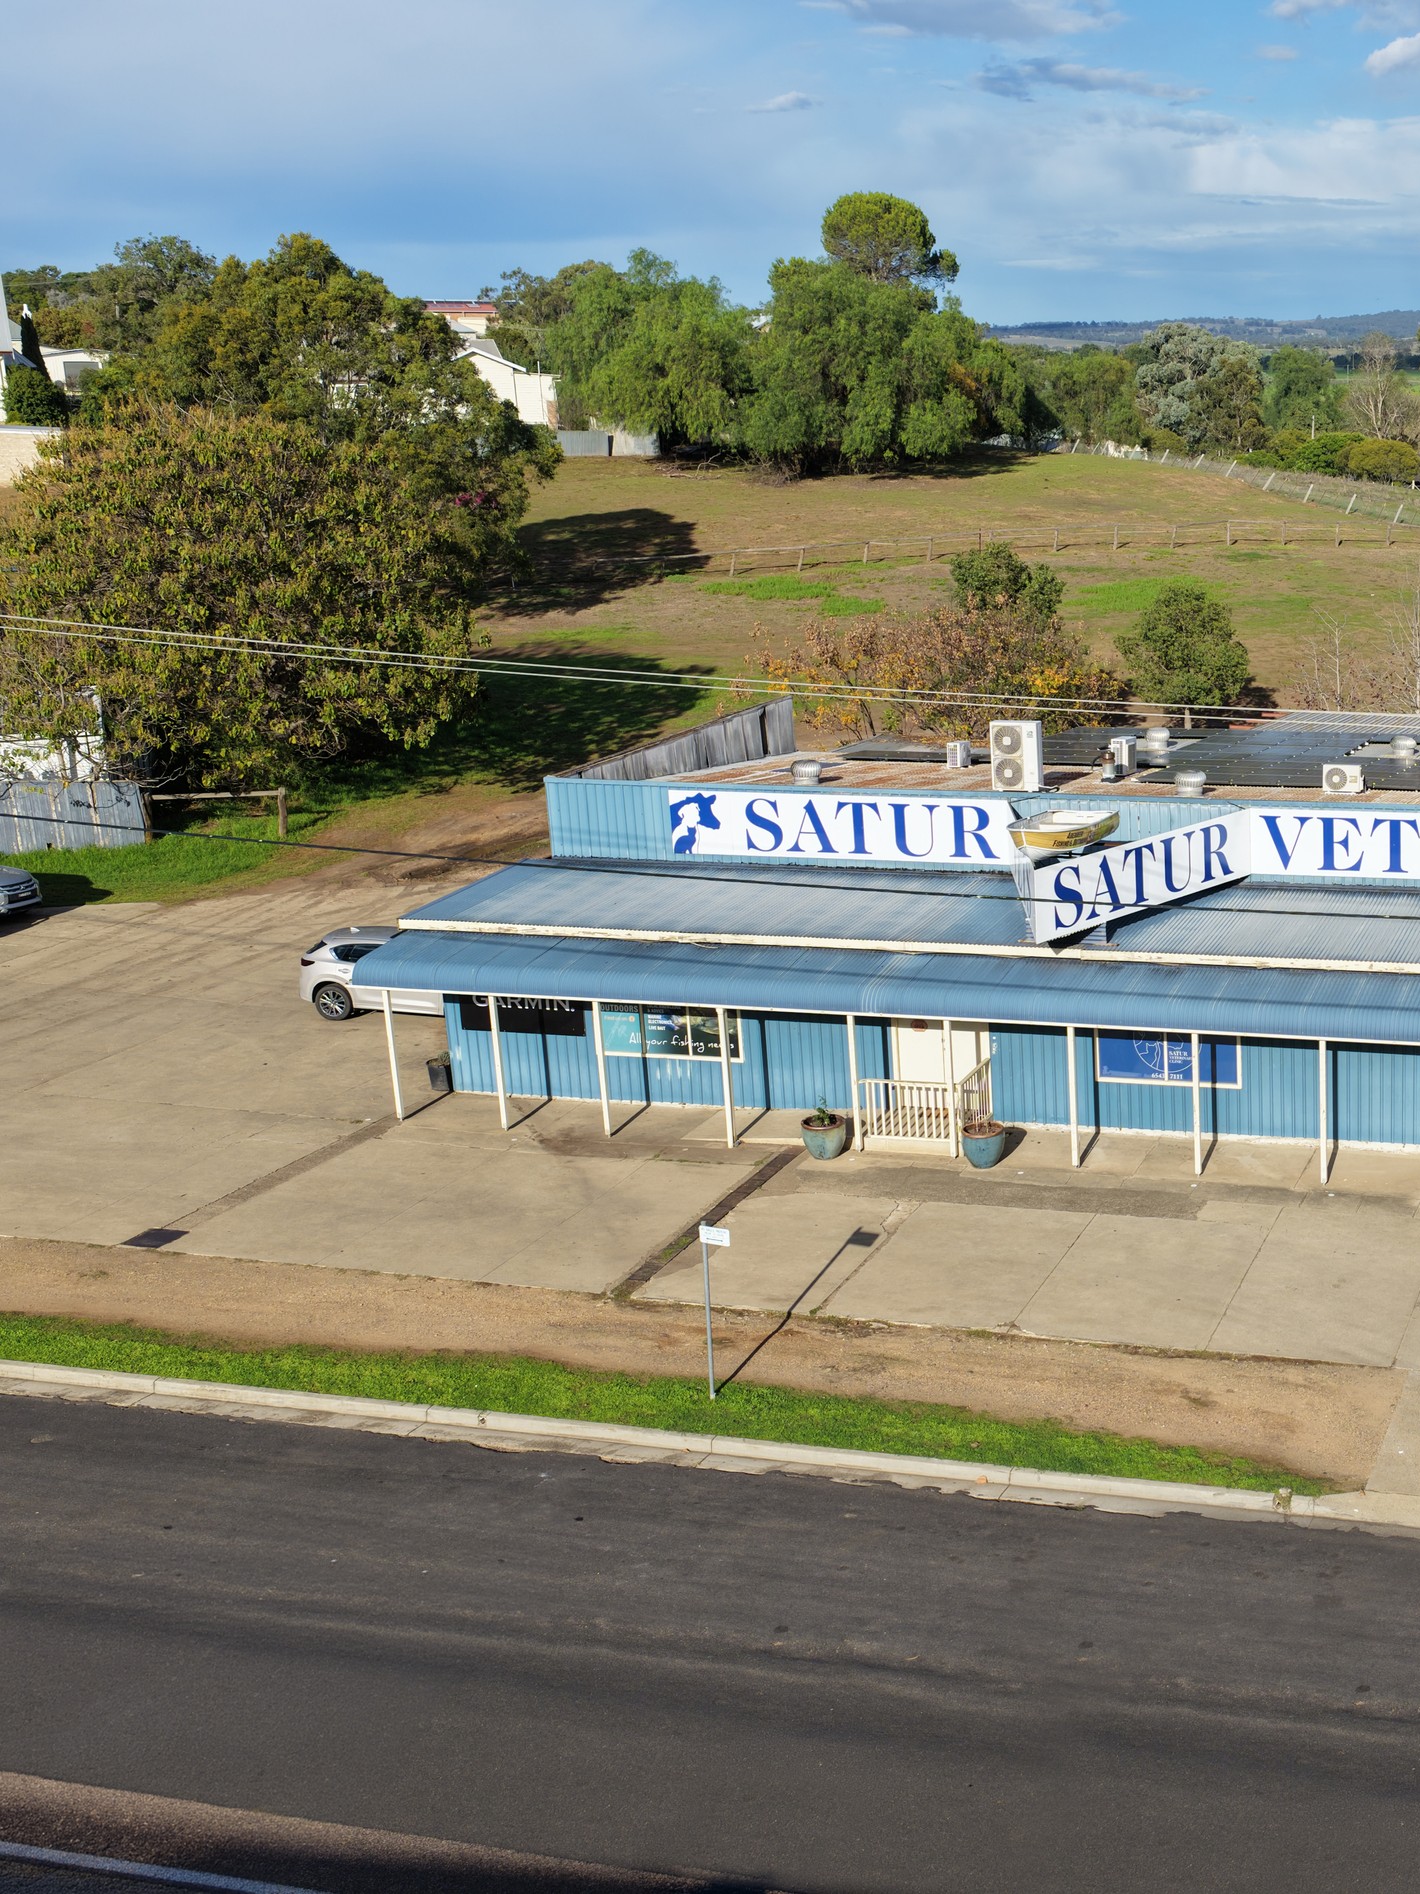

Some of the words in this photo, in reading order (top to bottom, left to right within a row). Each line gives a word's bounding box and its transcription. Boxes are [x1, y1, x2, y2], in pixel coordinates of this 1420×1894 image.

[745, 798, 995, 860] SATUR
[1053, 824, 1233, 930] SATUR
[600, 1003, 639, 1013] OUTDOORS
[629, 1032, 642, 1044] All
[646, 1039, 667, 1050] your
